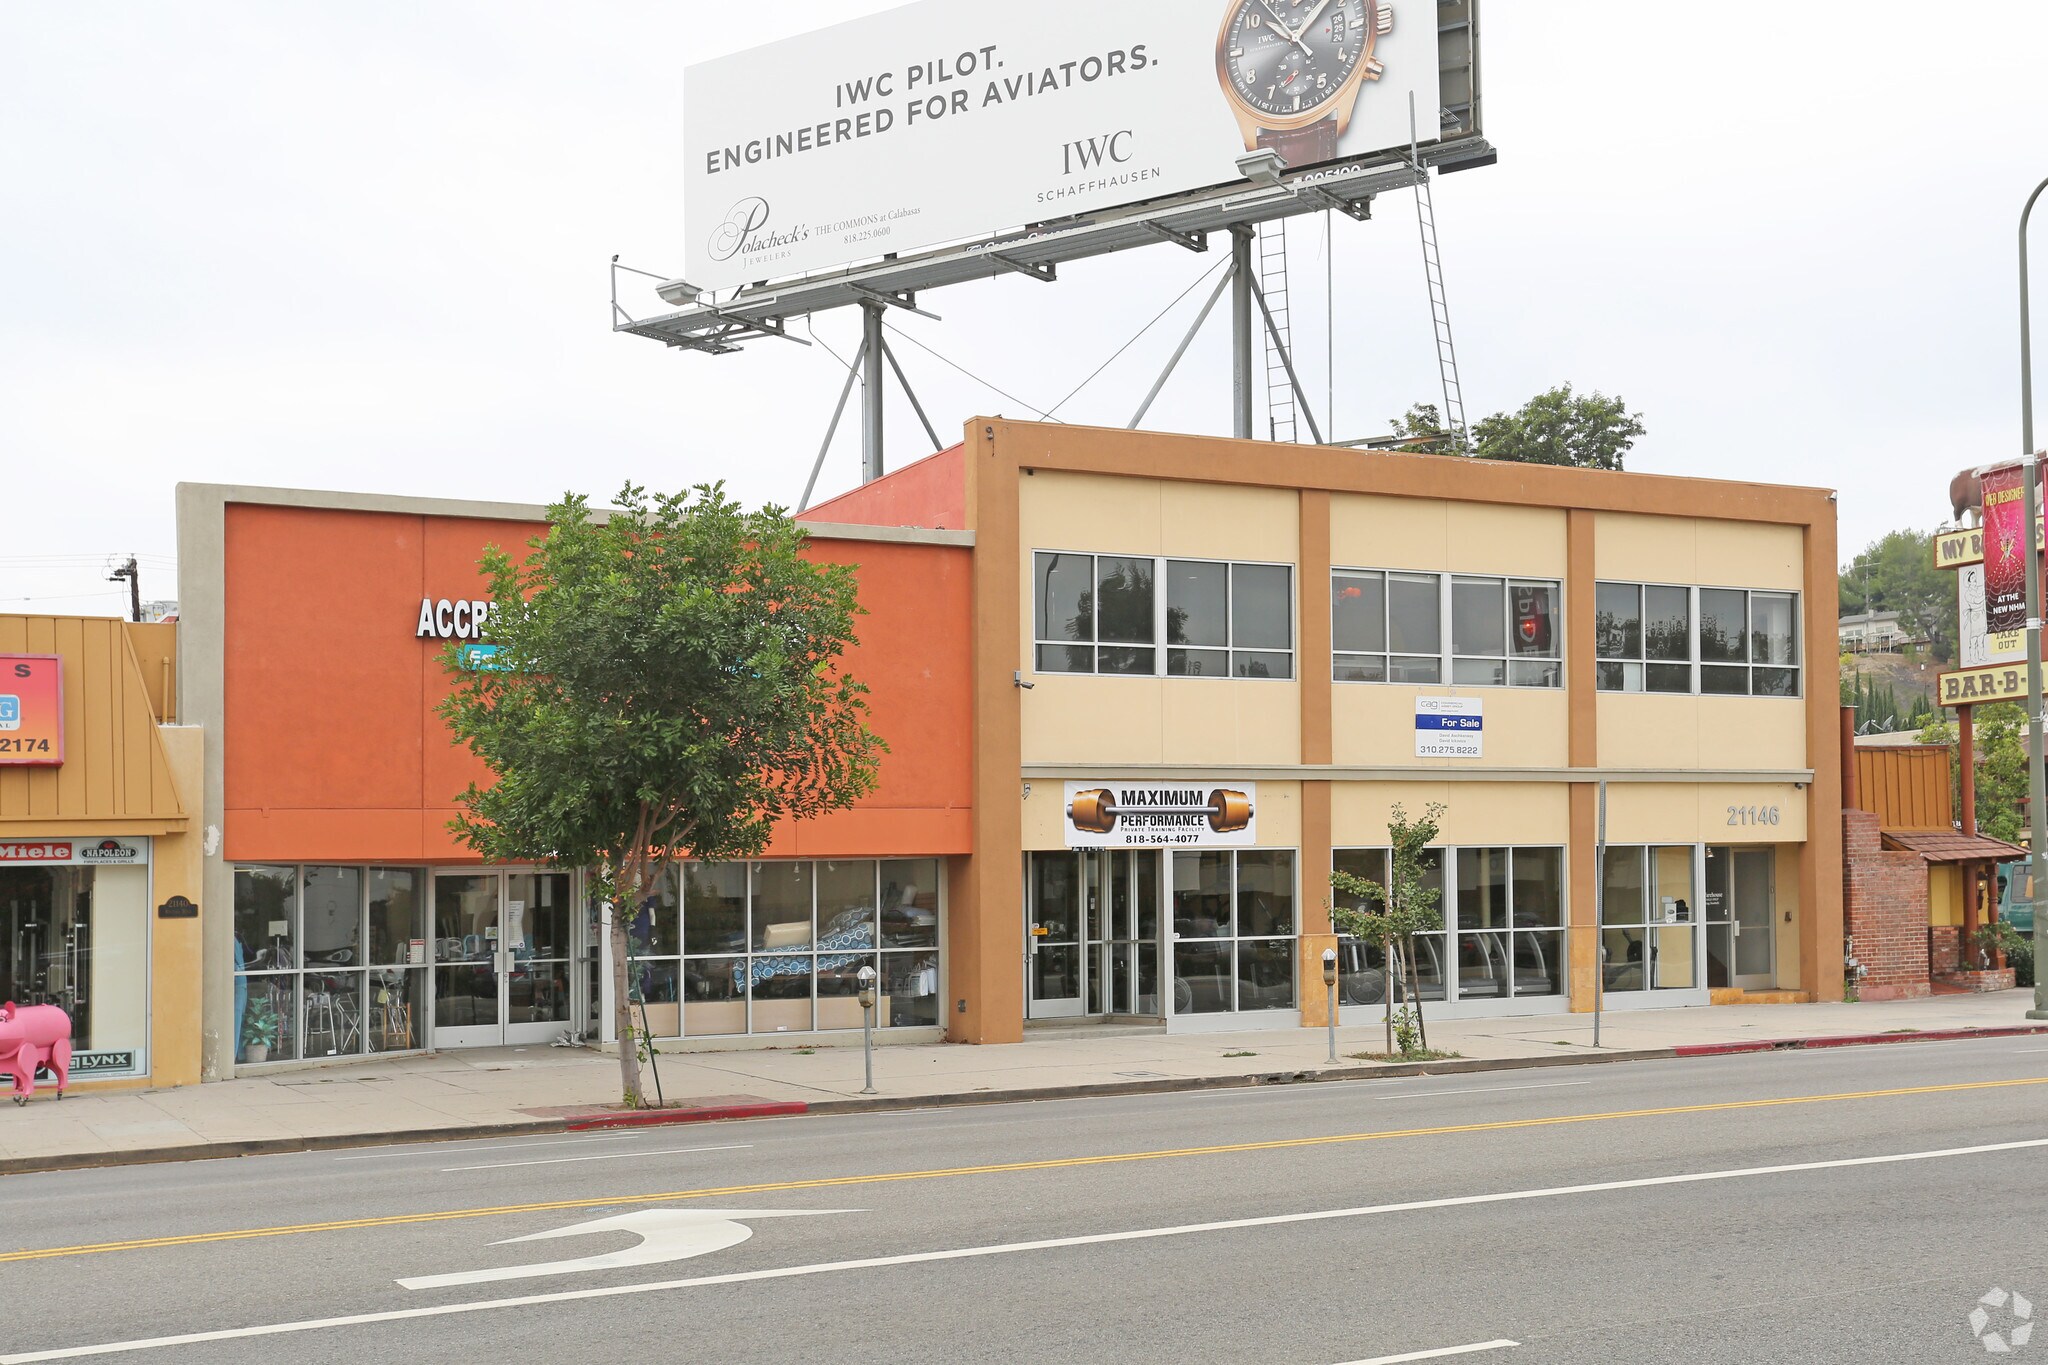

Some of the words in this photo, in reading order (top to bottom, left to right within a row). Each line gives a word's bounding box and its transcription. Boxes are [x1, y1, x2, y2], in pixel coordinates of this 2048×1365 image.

[1245, 13, 1261, 30] 10
[1333, 15, 1343, 24] 26
[1334, 24, 1344, 32] 25
[1258, 34, 1275, 44] IWC
[1333, 34, 1343, 42] 24
[1337, 47, 1348, 62] 4
[836, 72, 894, 108] IWC
[907, 45, 1004, 90] PILOT.
[1246, 69, 1256, 85] 8
[1316, 73, 1327, 89] 5
[1267, 85, 1276, 100] 7
[706, 108, 894, 175] ENGINEERED
[907, 89, 969, 126] FOR
[981, 44, 1158, 108] AVIATORS.
[1061, 129, 1134, 176] IWC
[1037, 166, 1161, 203] SCHAFFHAUSEN
[707, 196, 810, 262] Polacheck's
[814, 225, 832, 237] THE
[833, 213, 878, 233] COMMONS
[879, 214, 887, 223] at
[887, 206, 921, 221] Calabasas
[843, 226, 891, 245] 818.225.0600
[743, 250, 792, 269] JEWELERS
[1985, 492, 1997, 507] WEB
[1942, 536, 1967, 561] MY
[1997, 594, 2008, 604] AT
[2008, 592, 2019, 602] THE
[1993, 604, 2008, 615] NEW
[2009, 602, 2026, 613] NHM
[1995, 629, 2020, 640] TAKE
[1998, 639, 2017, 650] OUT
[1945, 669, 2044, 700] BAR-B-
[1420, 700, 1438, 710] cag
[1441, 718, 1458, 727] For
[1460, 718, 1480, 728] Sale
[1420, 745, 1478, 755] 310.275.8222
[1121, 790, 1203, 806] MAXIMUM
[1120, 814, 1204, 827] PERFORMANCE
[1726, 805, 1780, 825] 21146
[1125, 835, 1199, 844] 818-564-4077
[0, 845, 70, 858] Miele
[86, 848, 132, 857] NAPOLEON
[82, 1054, 128, 1068] LYNX
